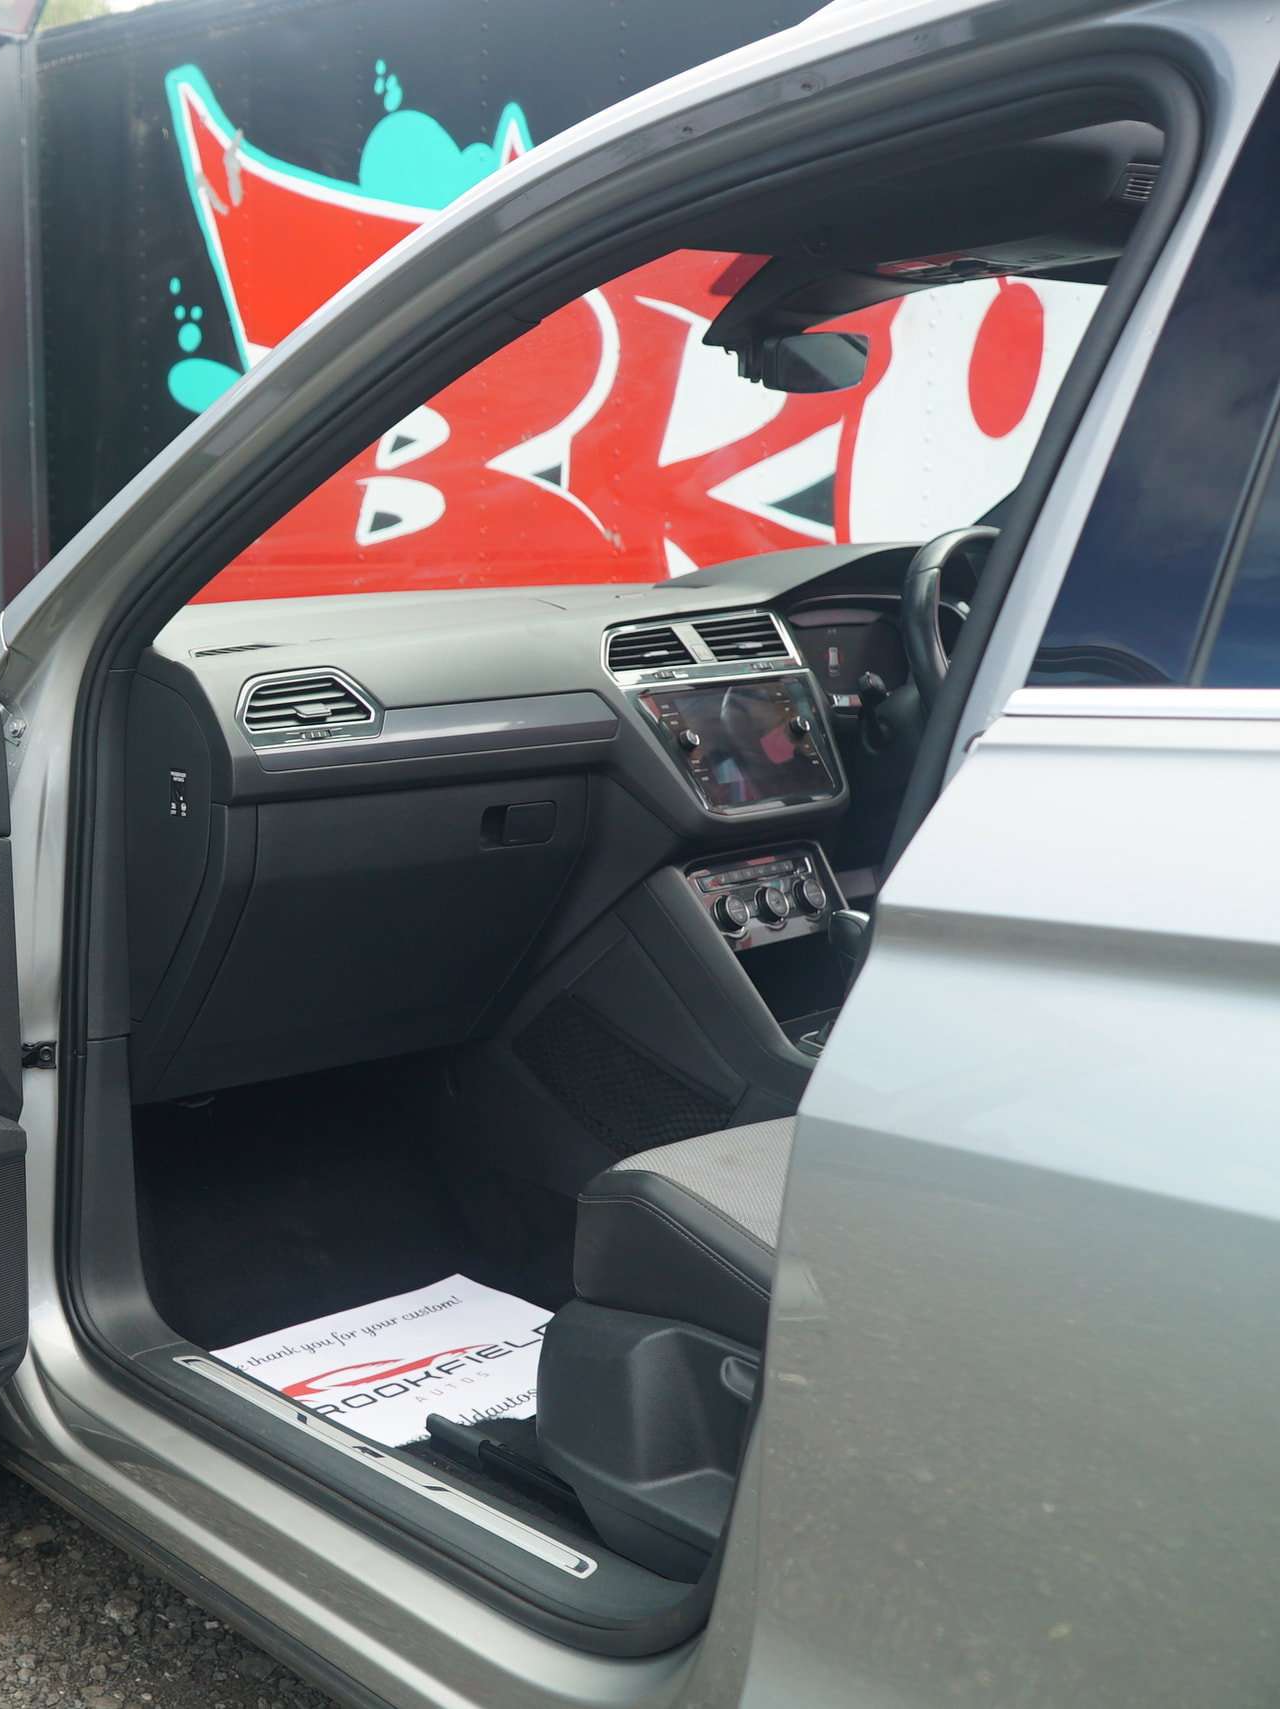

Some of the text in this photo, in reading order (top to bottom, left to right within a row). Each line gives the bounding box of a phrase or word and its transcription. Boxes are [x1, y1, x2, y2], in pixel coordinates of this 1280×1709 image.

[247, 1343, 301, 1368] thank
[299, 1337, 333, 1355] you
[330, 1330, 357, 1347] for
[360, 1317, 398, 1337] your
[402, 1295, 463, 1321] custom!
[415, 1370, 490, 1403] AUTOS
